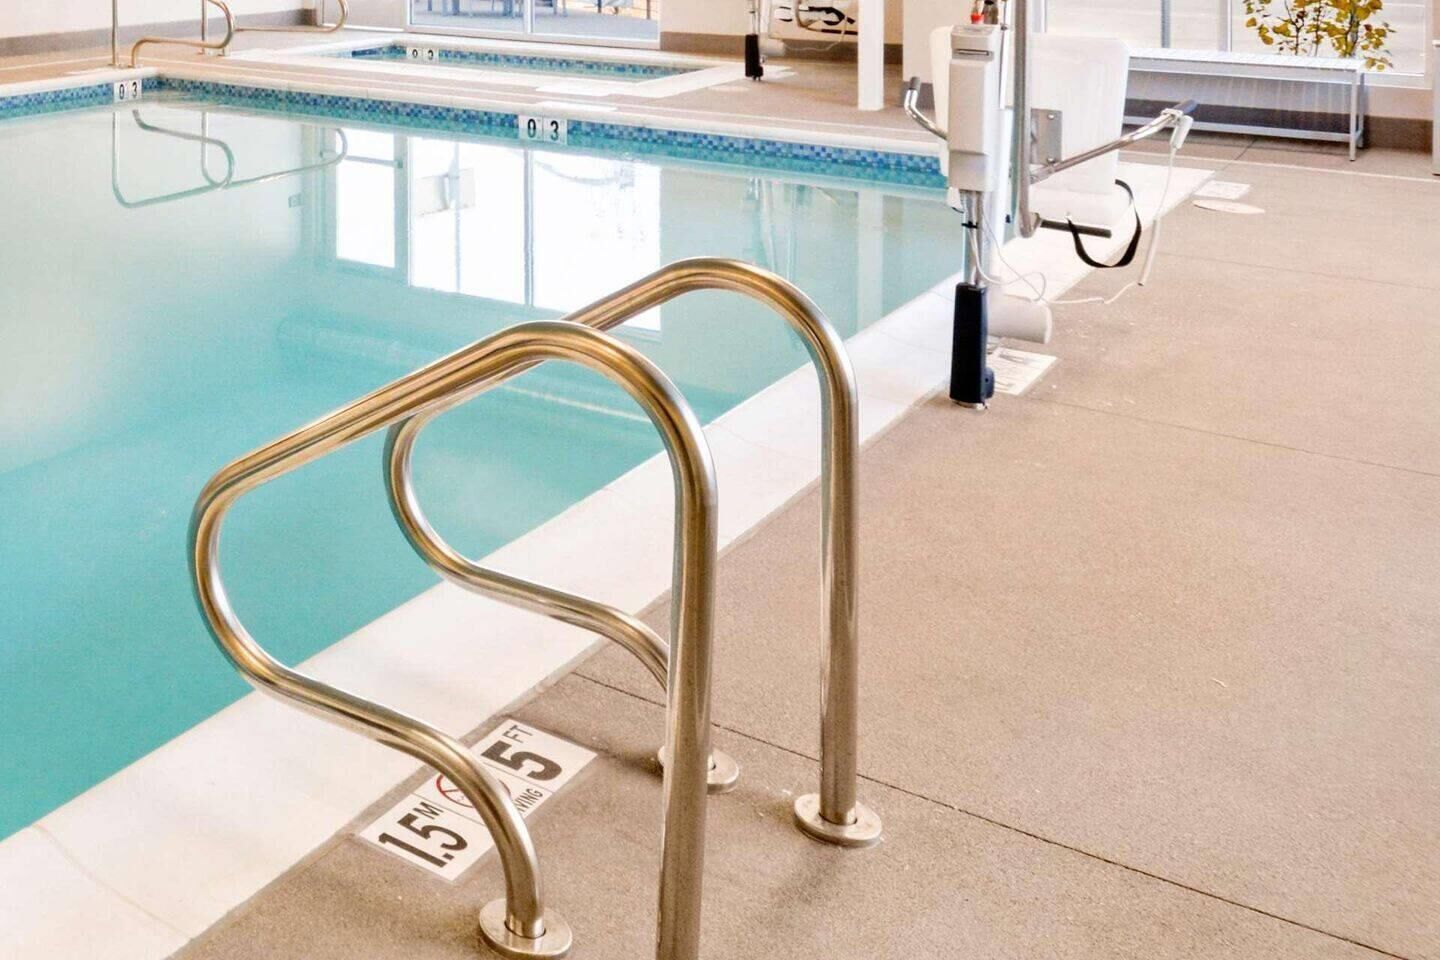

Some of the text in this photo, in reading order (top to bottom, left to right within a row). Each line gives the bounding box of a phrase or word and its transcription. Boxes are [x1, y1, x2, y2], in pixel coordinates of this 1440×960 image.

[481, 724, 563, 781] 5 FT
[378, 801, 469, 868] 1.5 M
